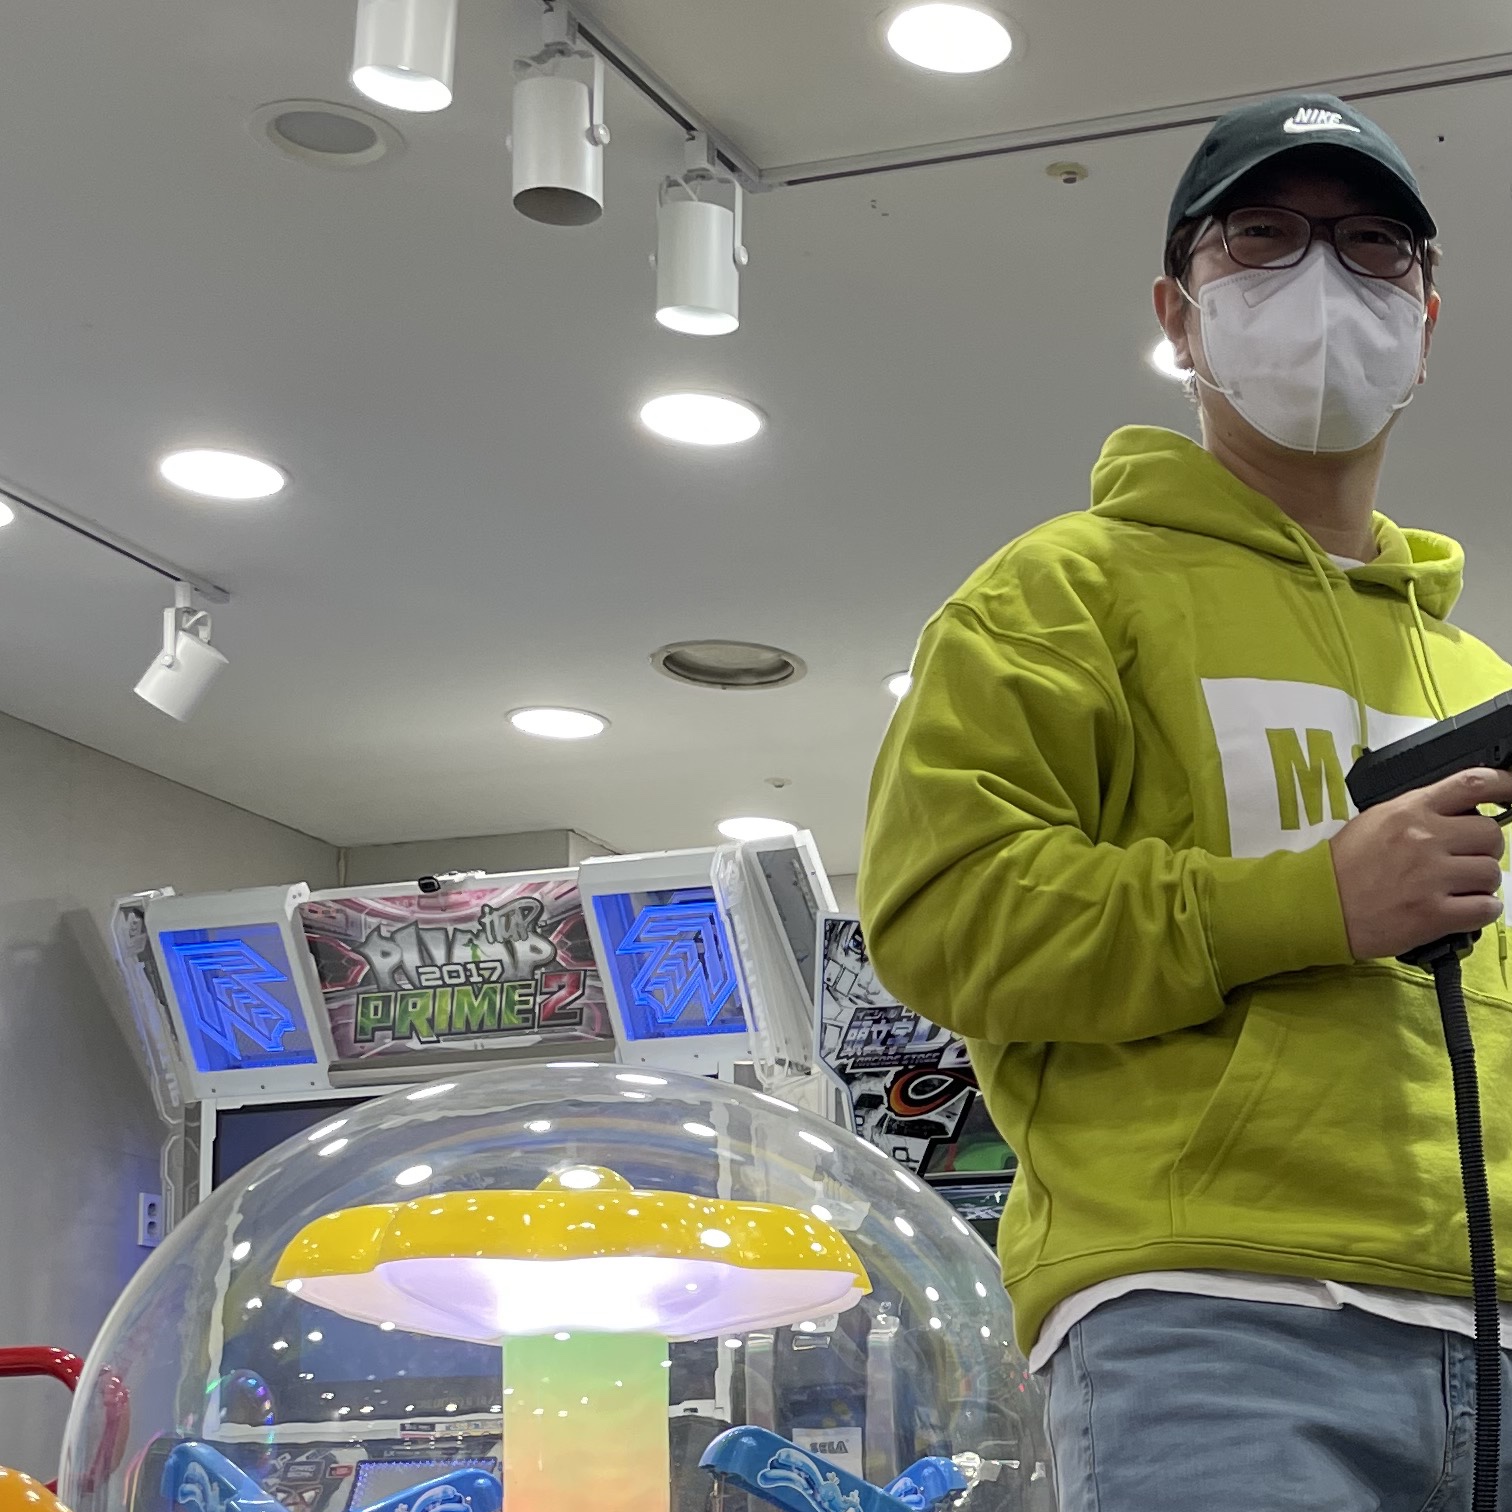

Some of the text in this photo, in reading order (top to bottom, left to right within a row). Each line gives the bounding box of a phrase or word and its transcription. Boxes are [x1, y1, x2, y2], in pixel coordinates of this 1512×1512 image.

[1293, 107, 1342, 124] NIKE
[417, 961, 504, 988] 2017
[354, 970, 586, 1044] PRIME 2
